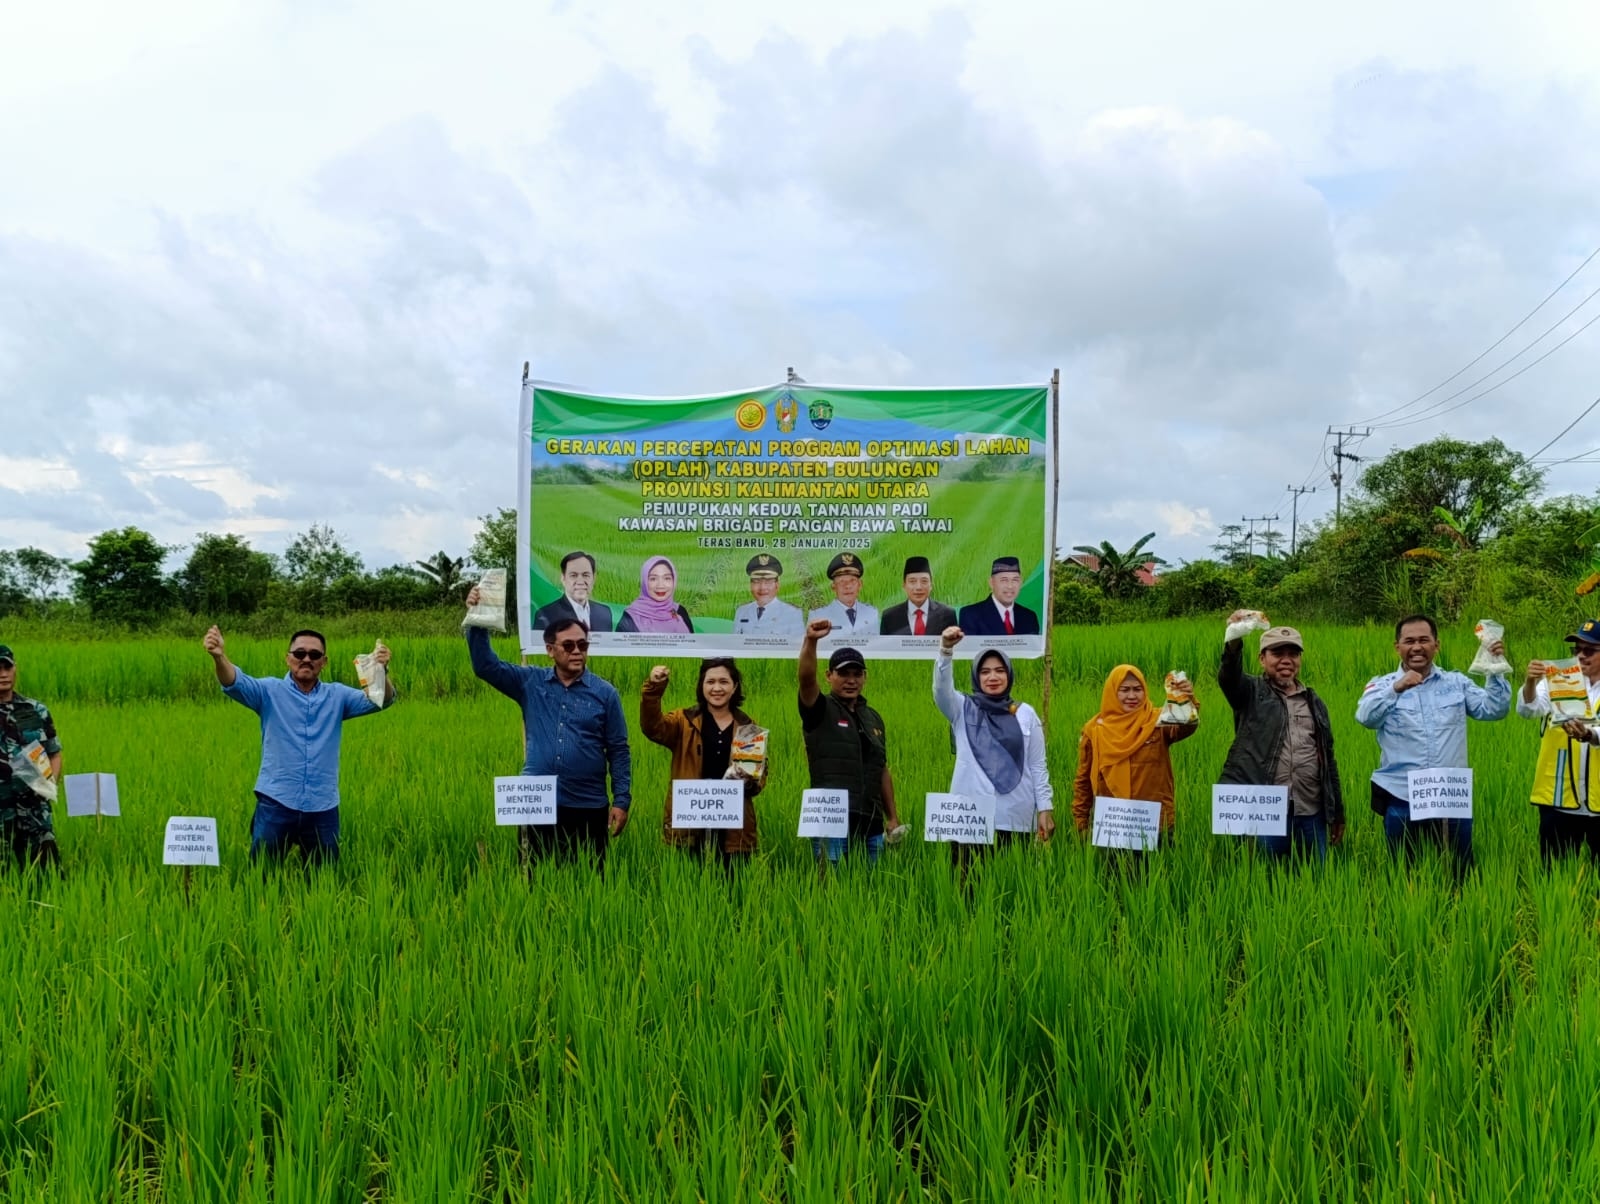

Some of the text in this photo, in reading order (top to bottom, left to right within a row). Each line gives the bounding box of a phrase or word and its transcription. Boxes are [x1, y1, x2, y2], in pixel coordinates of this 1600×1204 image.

[546, 438, 1030, 457] GERAKAN PERCEPATAN PROGRAM OPTIMASI LAHAN
[633, 461, 939, 480] (OPLAH) KABUPATEN BULUNGAN
[642, 481, 929, 498] PROVINSI KALIMANTAN UTARA
[644, 502, 928, 517] PEMUPUKAN KEDUA TANAMAN PADI
[618, 518, 953, 533] KAWASAN BRIGADE PANGAN BAWA TAWAI
[698, 538, 870, 549] TERAS BARU, 28 JANUARI 2025
[1413, 776, 1468, 786] KEPALA DINAS
[497, 784, 553, 792] STAF KHUSUS
[678, 788, 739, 796] KEPALA DINAS
[1412, 787, 1469, 800] PERTANIAN
[506, 794, 542, 804] MENTERI
[1218, 794, 1282, 804] KEPALA BSIP
[690, 799, 725, 810] PUPR
[940, 802, 977, 811] KEPALA
[498, 806, 553, 815] PERTANIAN RI
[1108, 806, 1132, 814] KEPALA
[930, 814, 986, 825] PUSLATAN
[1248, 813, 1280, 821] KALTIM
[928, 826, 976, 836] KEMENTAN
